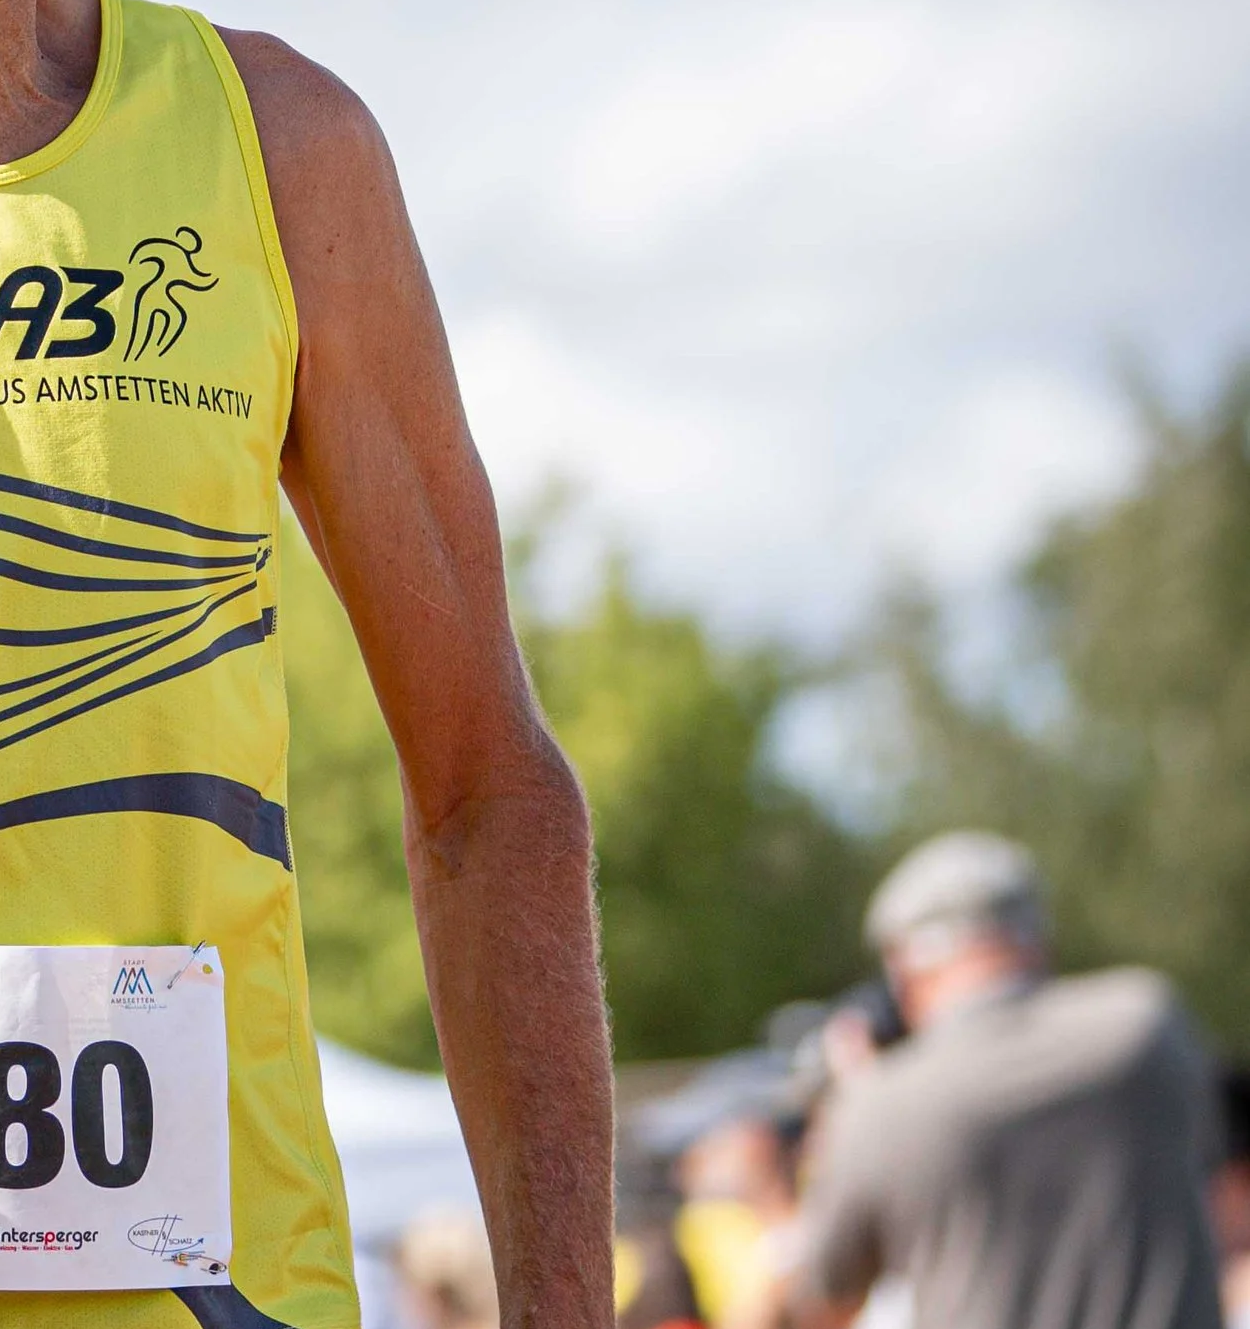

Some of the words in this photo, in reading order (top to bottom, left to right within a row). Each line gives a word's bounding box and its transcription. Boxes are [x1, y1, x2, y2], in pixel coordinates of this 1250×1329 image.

[36, 374, 190, 408] AMSTETTEN
[197, 384, 252, 420] AKTIV
[110, 997, 155, 1005] AMSTETTEN
